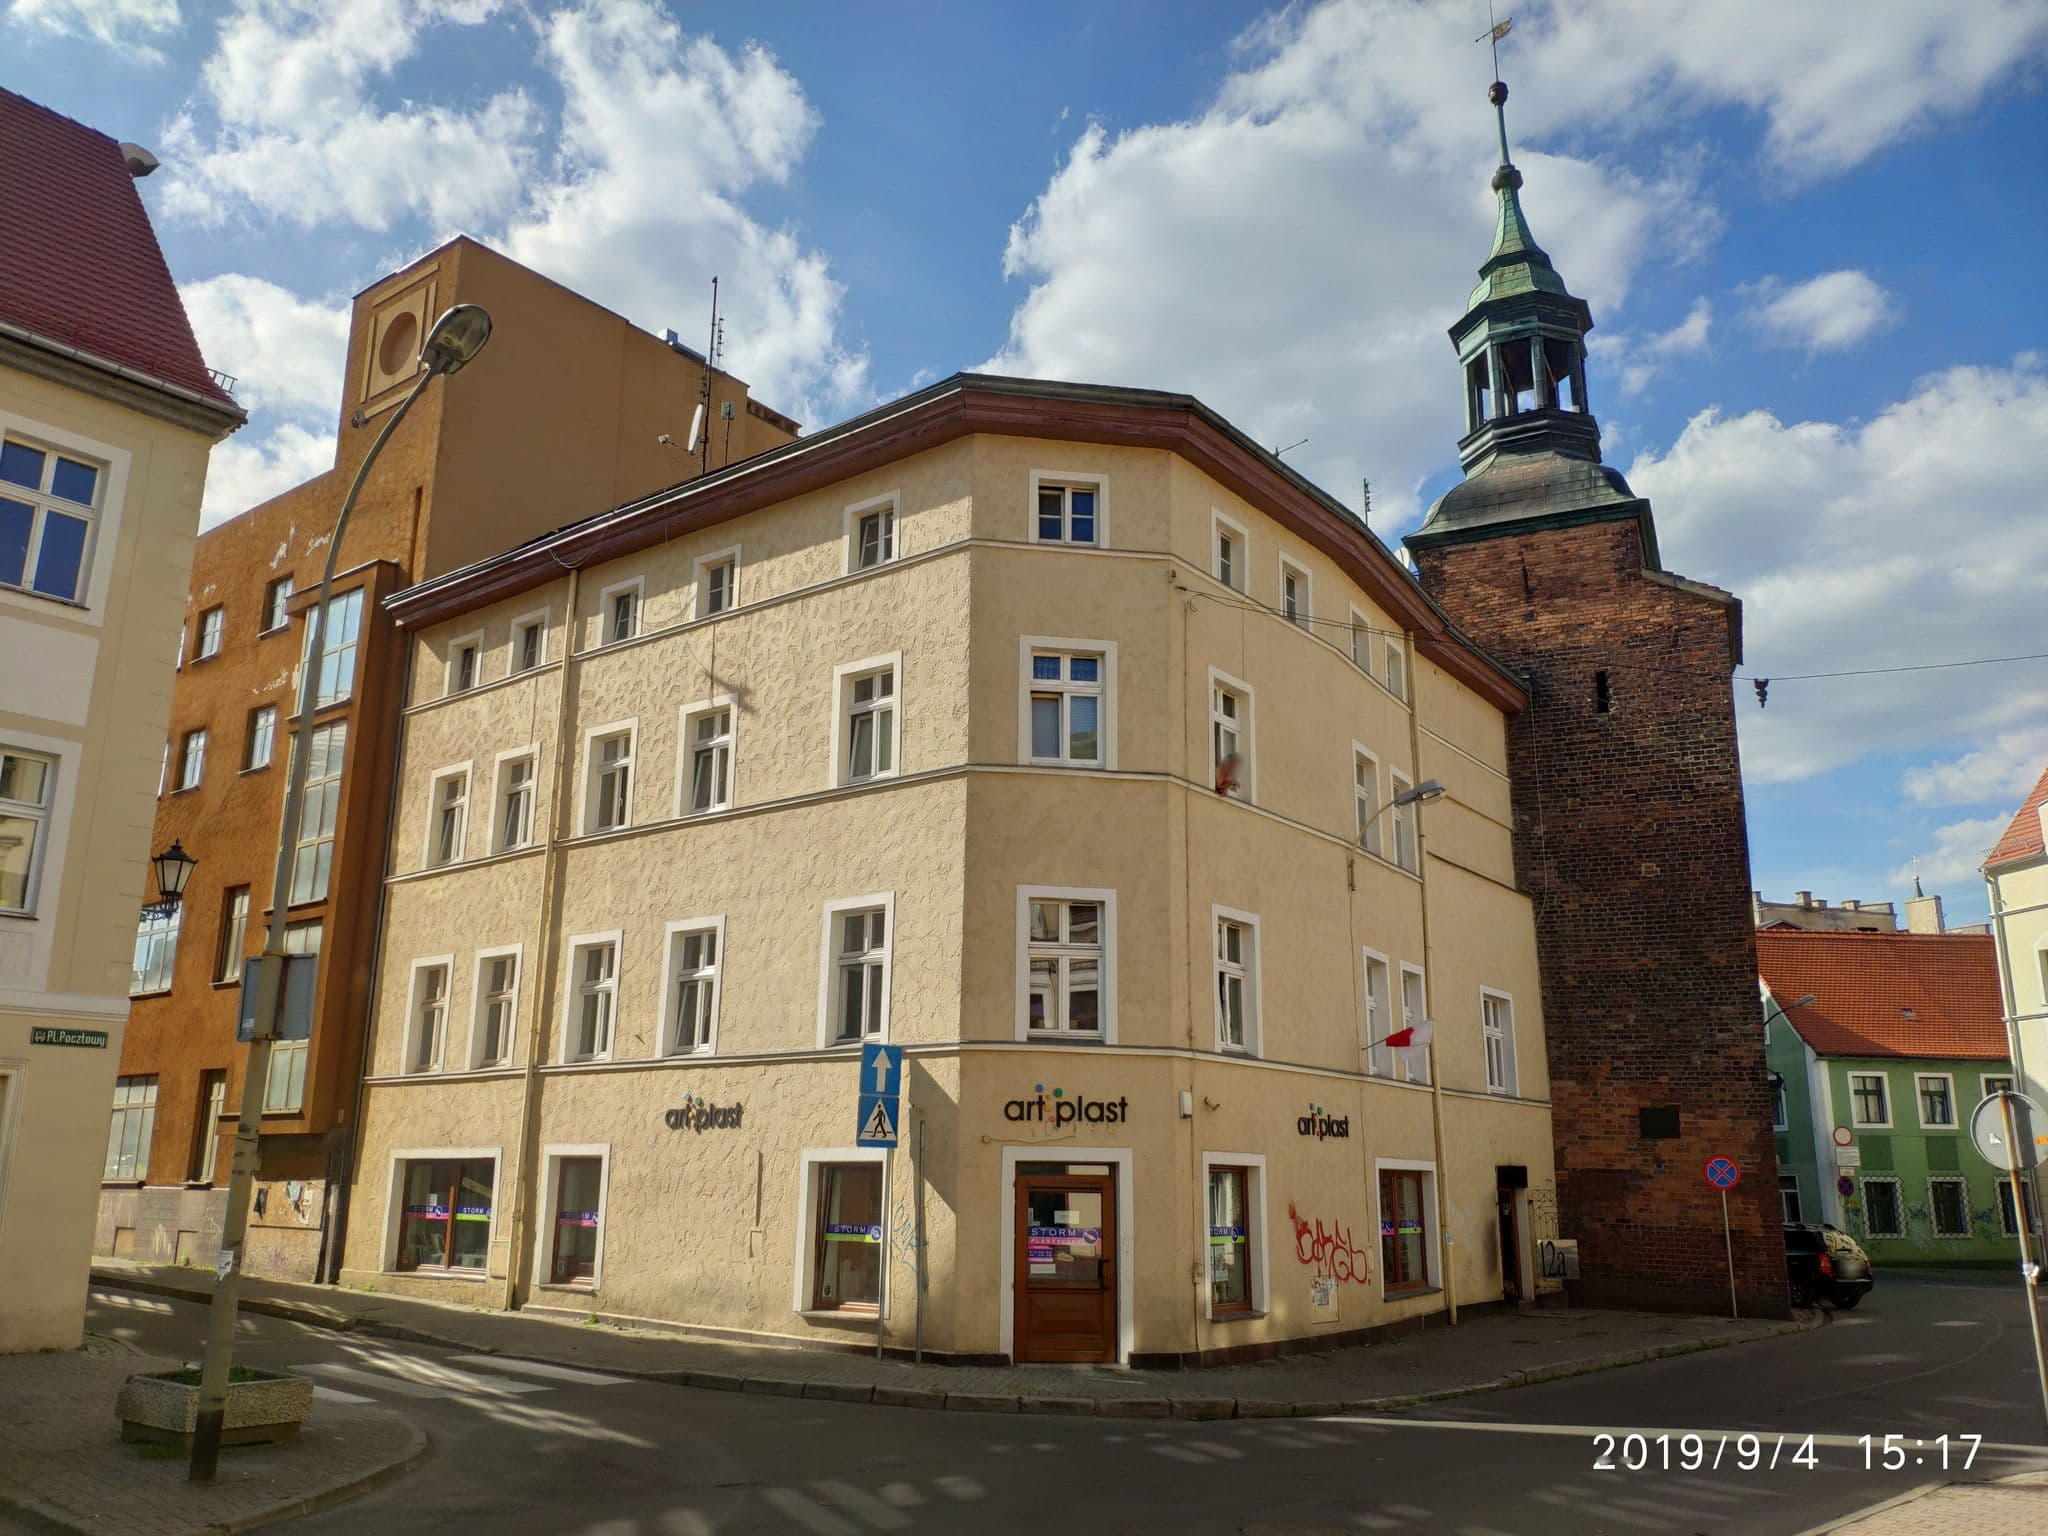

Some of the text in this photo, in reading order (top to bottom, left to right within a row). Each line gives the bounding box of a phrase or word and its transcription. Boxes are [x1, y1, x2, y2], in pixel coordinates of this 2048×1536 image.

[59, 1031, 106, 1047] Pocztowy
[834, 1225, 866, 1233] STORM
[1031, 1228, 1076, 1236] STORM
[1540, 1240, 1567, 1277] 12a
